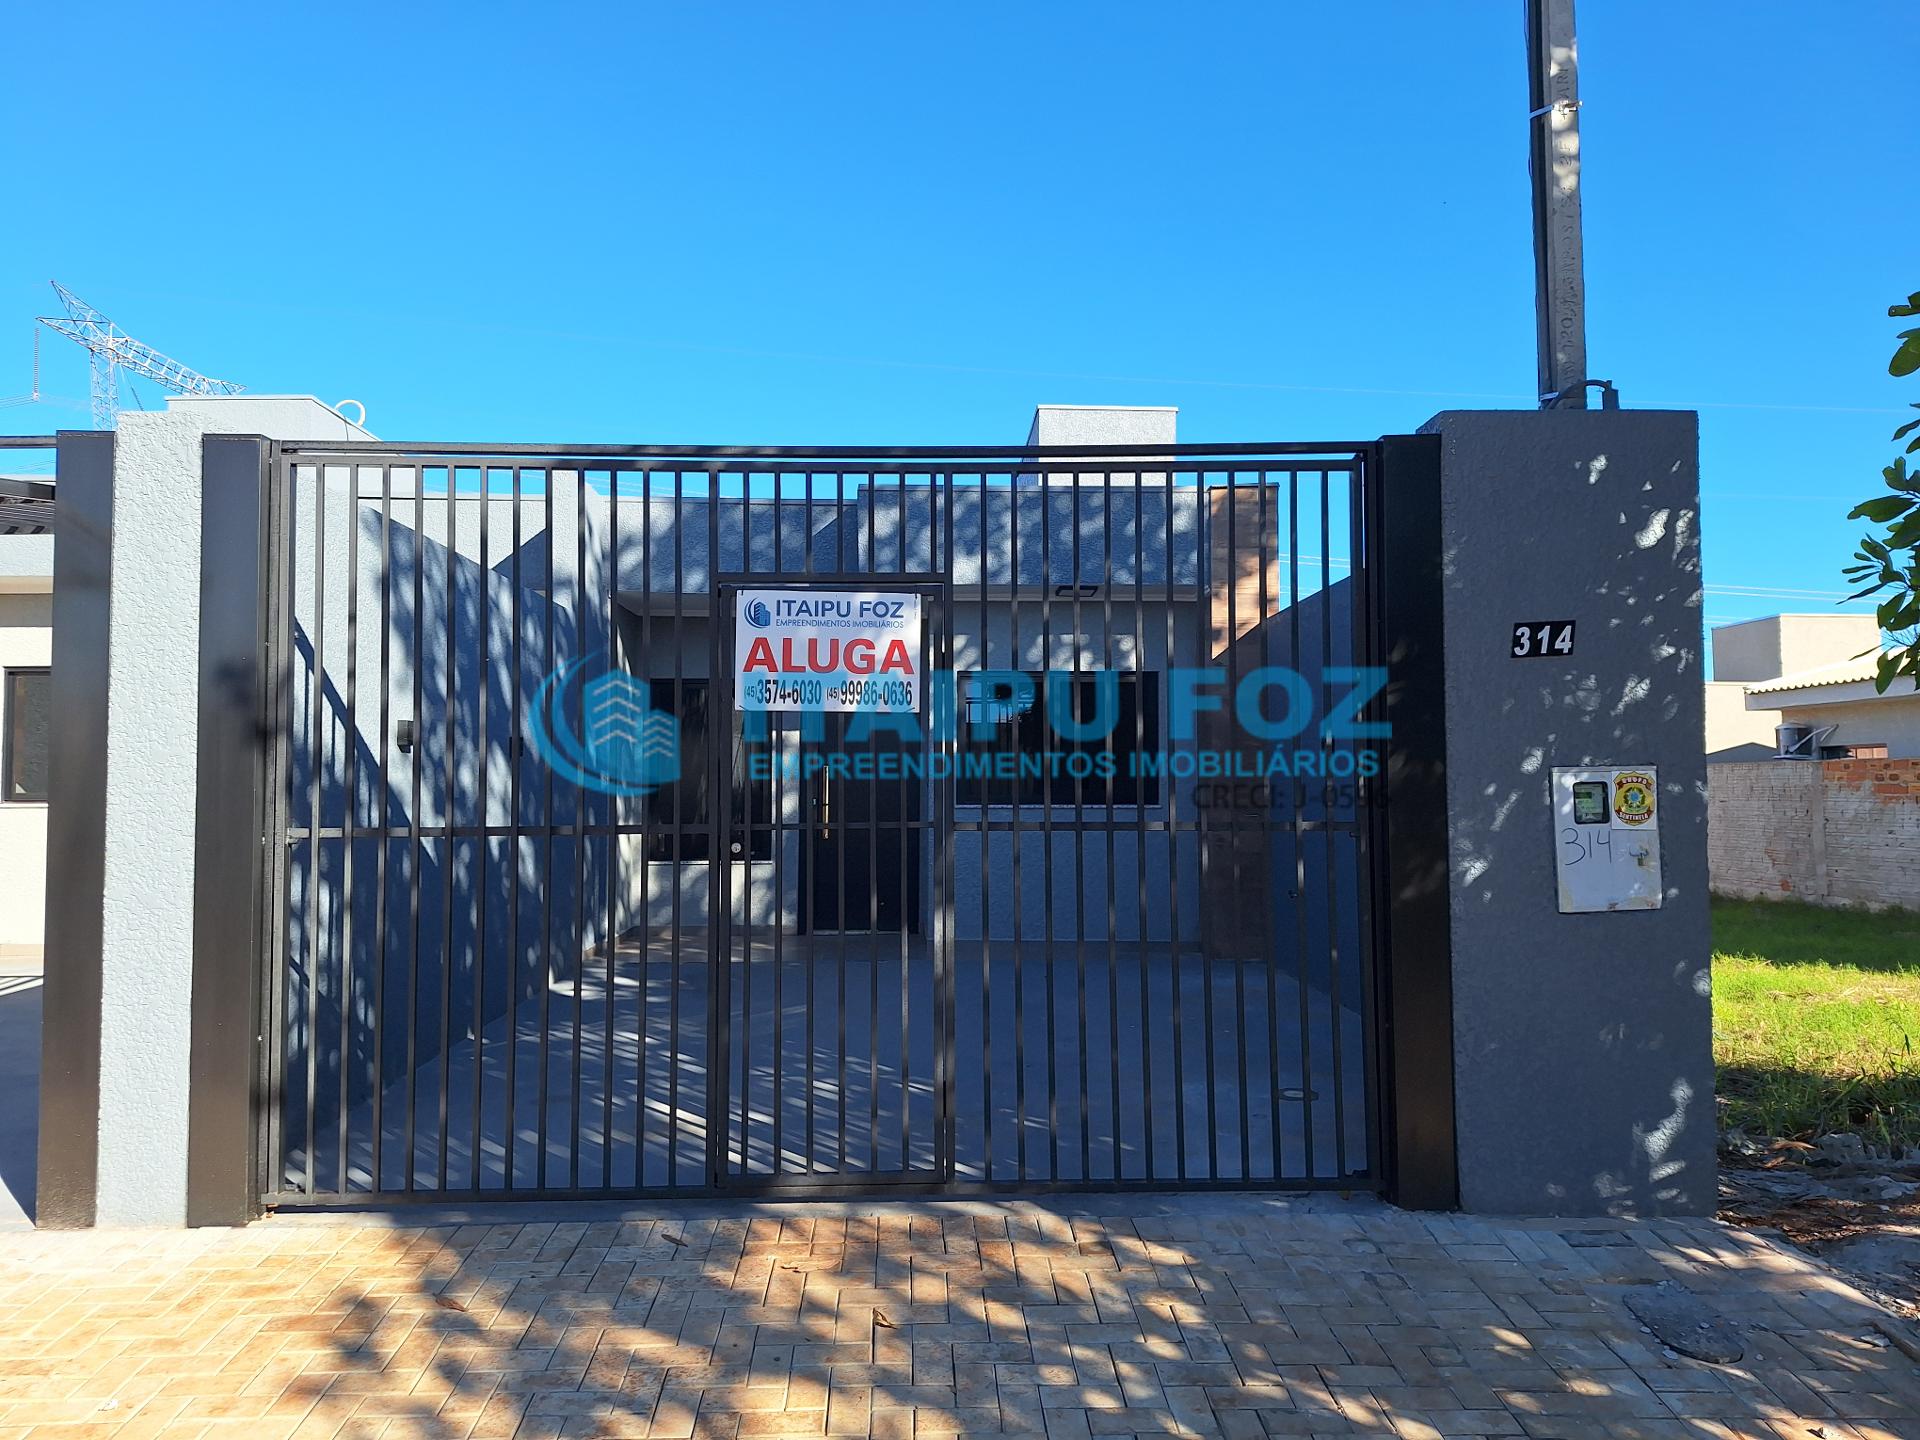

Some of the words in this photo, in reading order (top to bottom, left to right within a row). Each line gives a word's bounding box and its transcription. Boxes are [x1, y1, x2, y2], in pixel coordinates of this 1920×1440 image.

[775, 618, 851, 628] EMPREENDIMENTOS
[852, 618, 904, 629] IMOBILIÁRIOS
[776, 599, 851, 618] ITAIPU
[859, 601, 904, 619] FOZ
[742, 636, 915, 675] ALUGA
[1513, 625, 1572, 656] 314
[1561, 827, 1612, 866] 314
